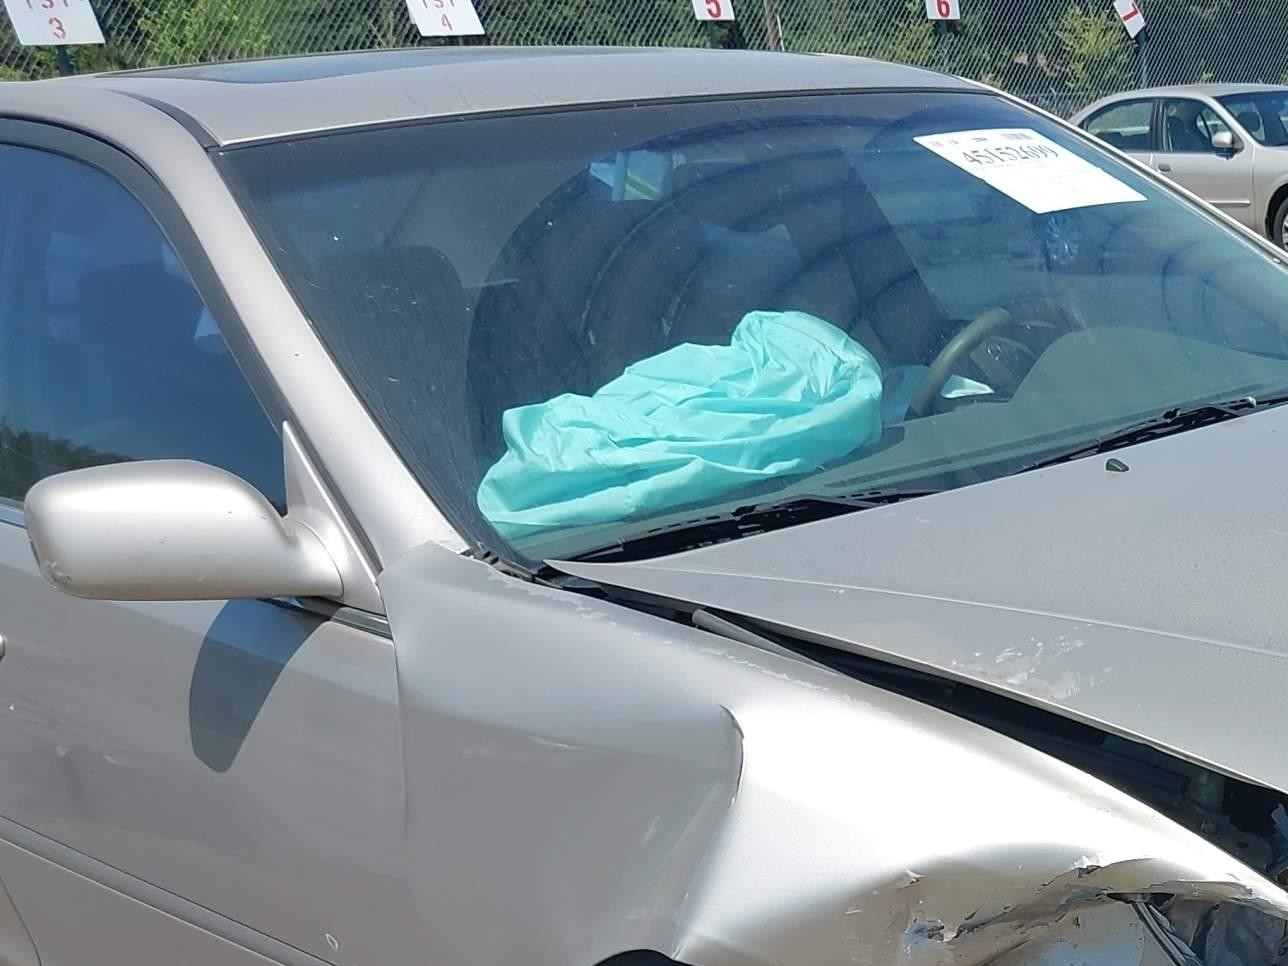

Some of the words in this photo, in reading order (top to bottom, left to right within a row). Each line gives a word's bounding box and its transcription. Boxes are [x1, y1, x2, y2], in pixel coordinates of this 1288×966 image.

[705, 0, 721, 18] 5
[936, 0, 950, 17] 6
[48, 17, 66, 39] 3
[441, 14, 453, 31] 4
[961, 145, 1059, 165] 45152699
